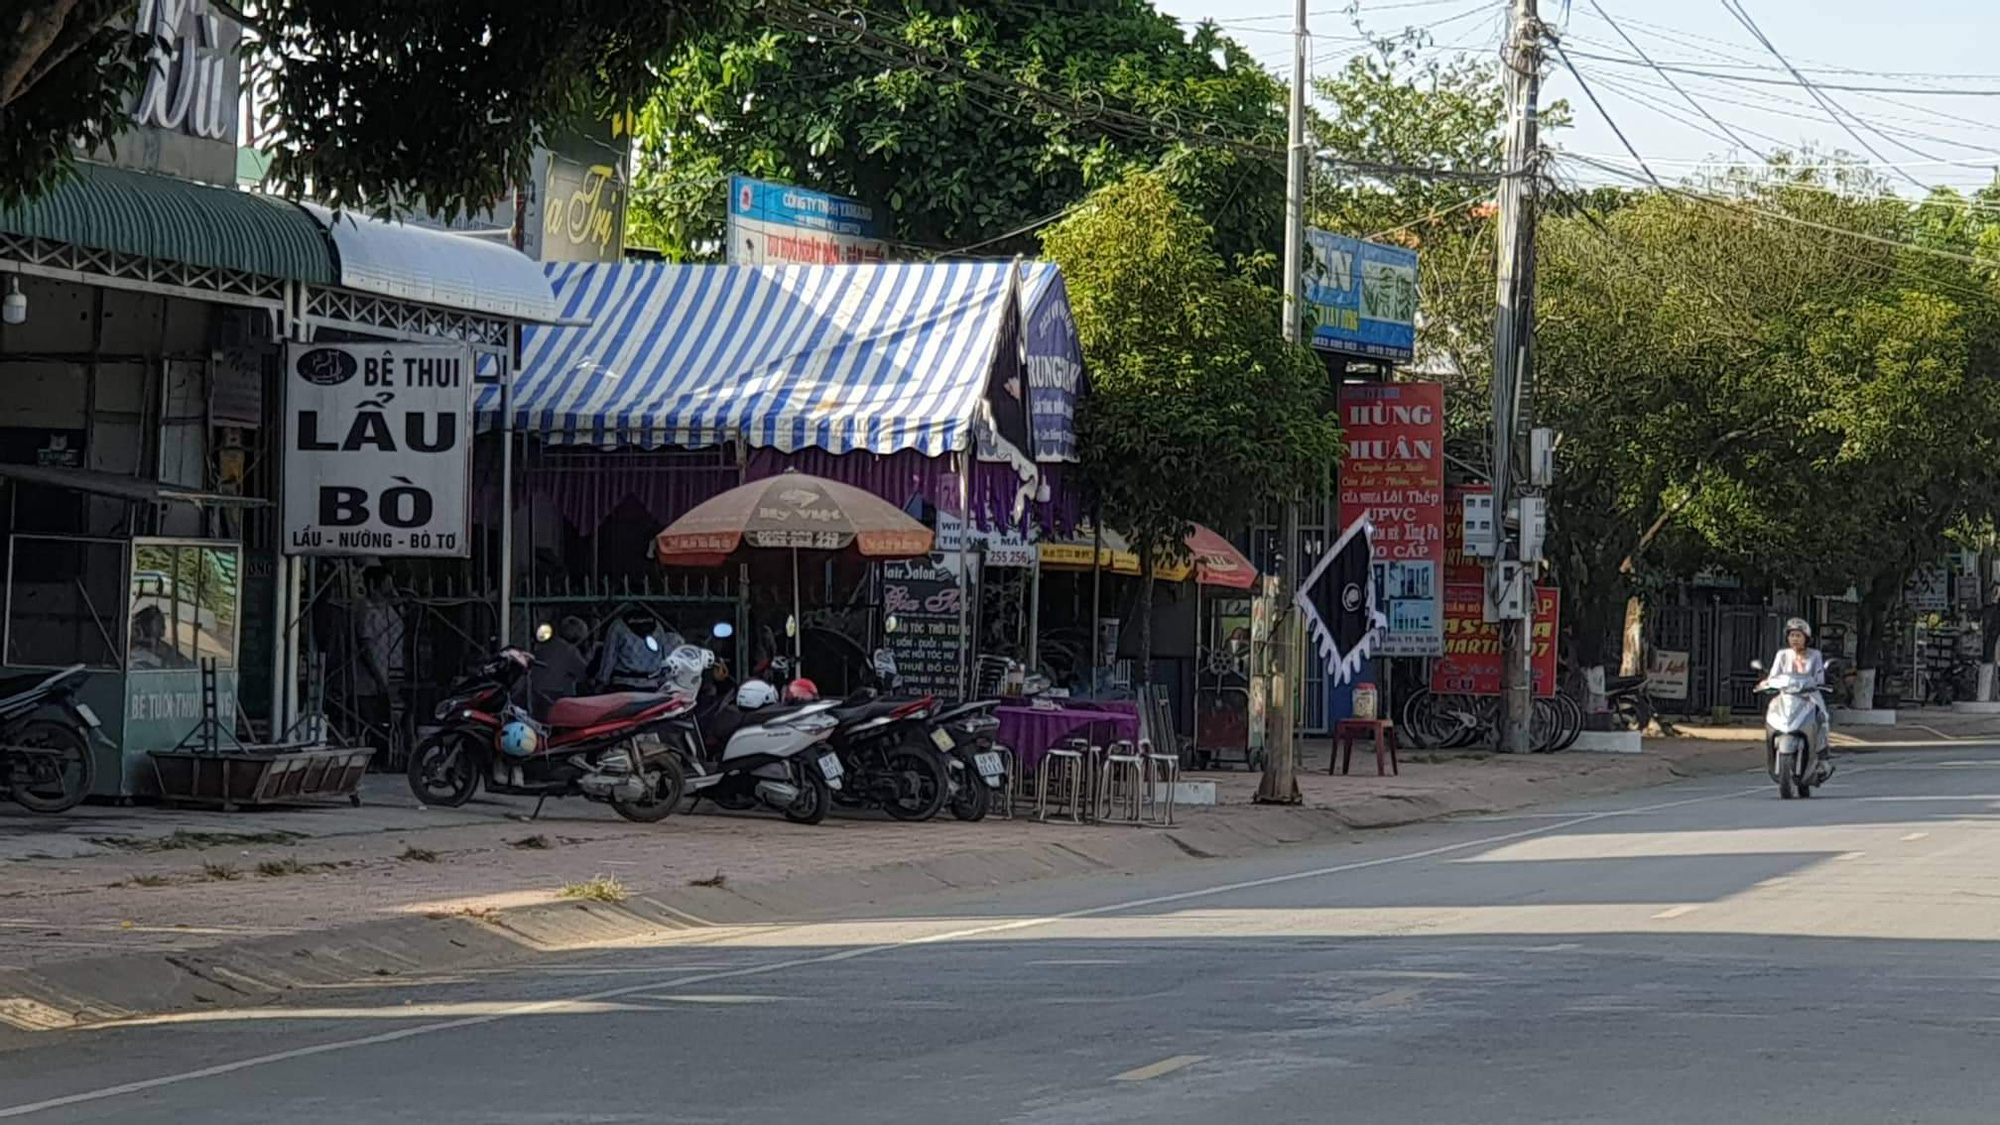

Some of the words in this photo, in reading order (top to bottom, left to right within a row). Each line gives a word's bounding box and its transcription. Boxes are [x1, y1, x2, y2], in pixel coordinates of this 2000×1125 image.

[403, 358, 460, 388] THUI
[297, 391, 456, 453] LẨU
[318, 476, 434, 528] BÒ
[410, 531, 431, 549] BÒ
[904, 559, 936, 580] Salon
[990, 551, 1008, 563] 255
